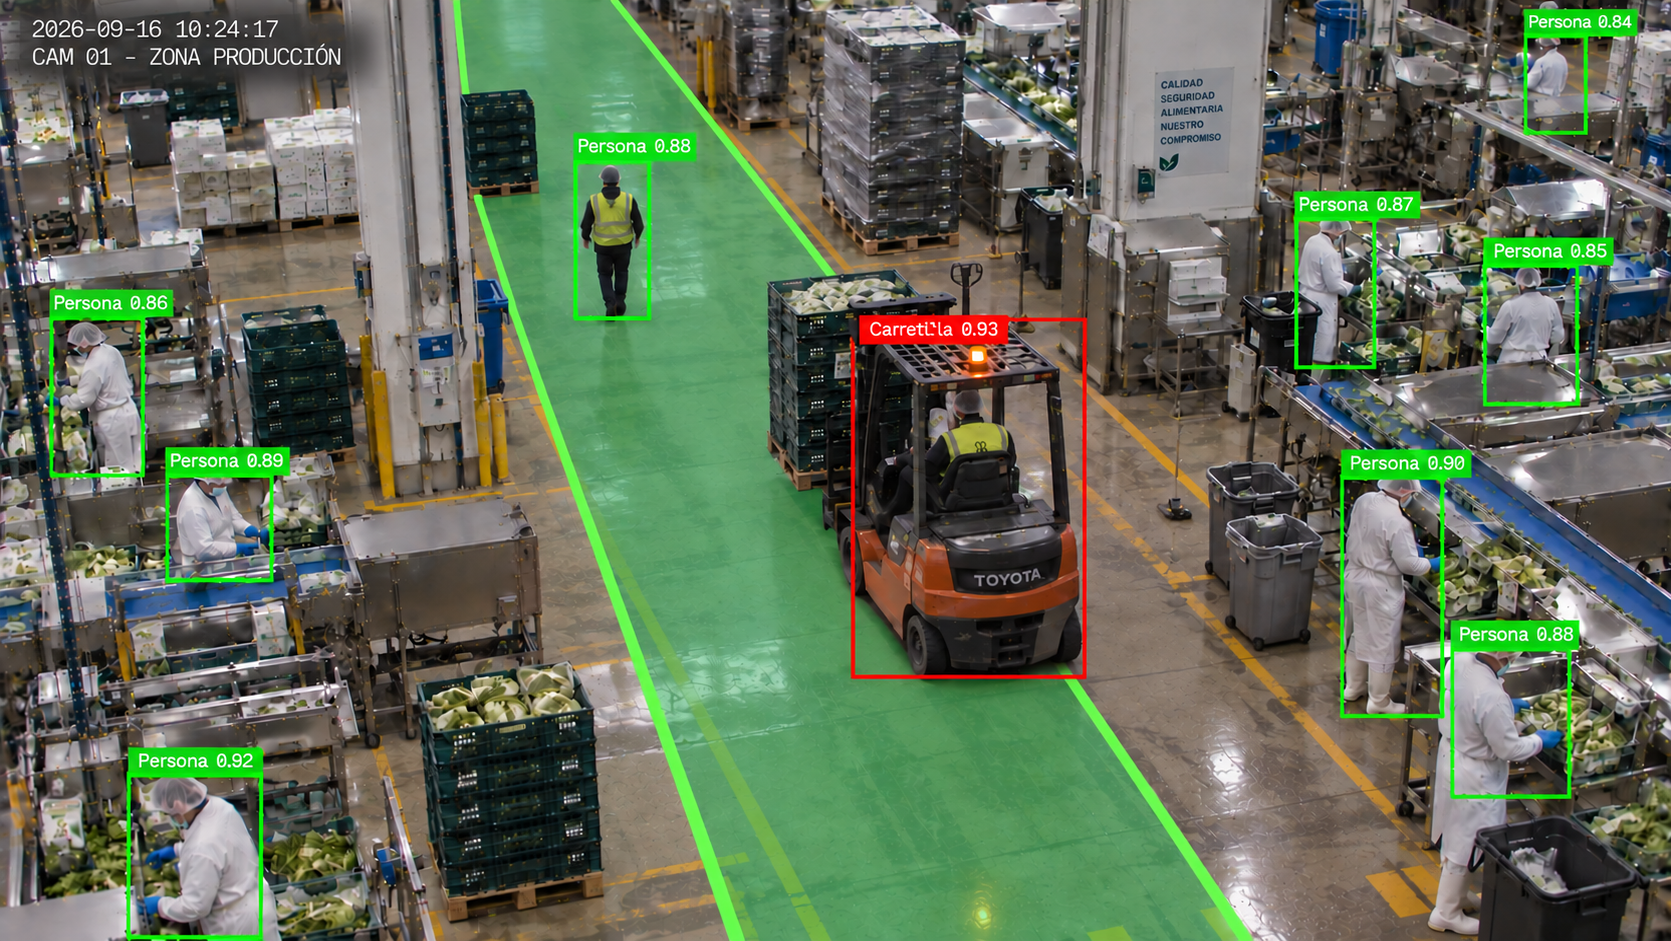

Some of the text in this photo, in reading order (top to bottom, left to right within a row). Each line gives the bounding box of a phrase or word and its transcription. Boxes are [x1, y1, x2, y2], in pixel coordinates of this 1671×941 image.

[1161, 78, 1203, 89] CALIDAD
[1161, 91, 1215, 103] SEGURIDAD
[1161, 105, 1223, 117] ALIMENTARIA
[1161, 120, 1204, 131] NUESTRO
[1160, 133, 1221, 145] COMPROMISO
[974, 568, 1041, 587] TOYOTA
